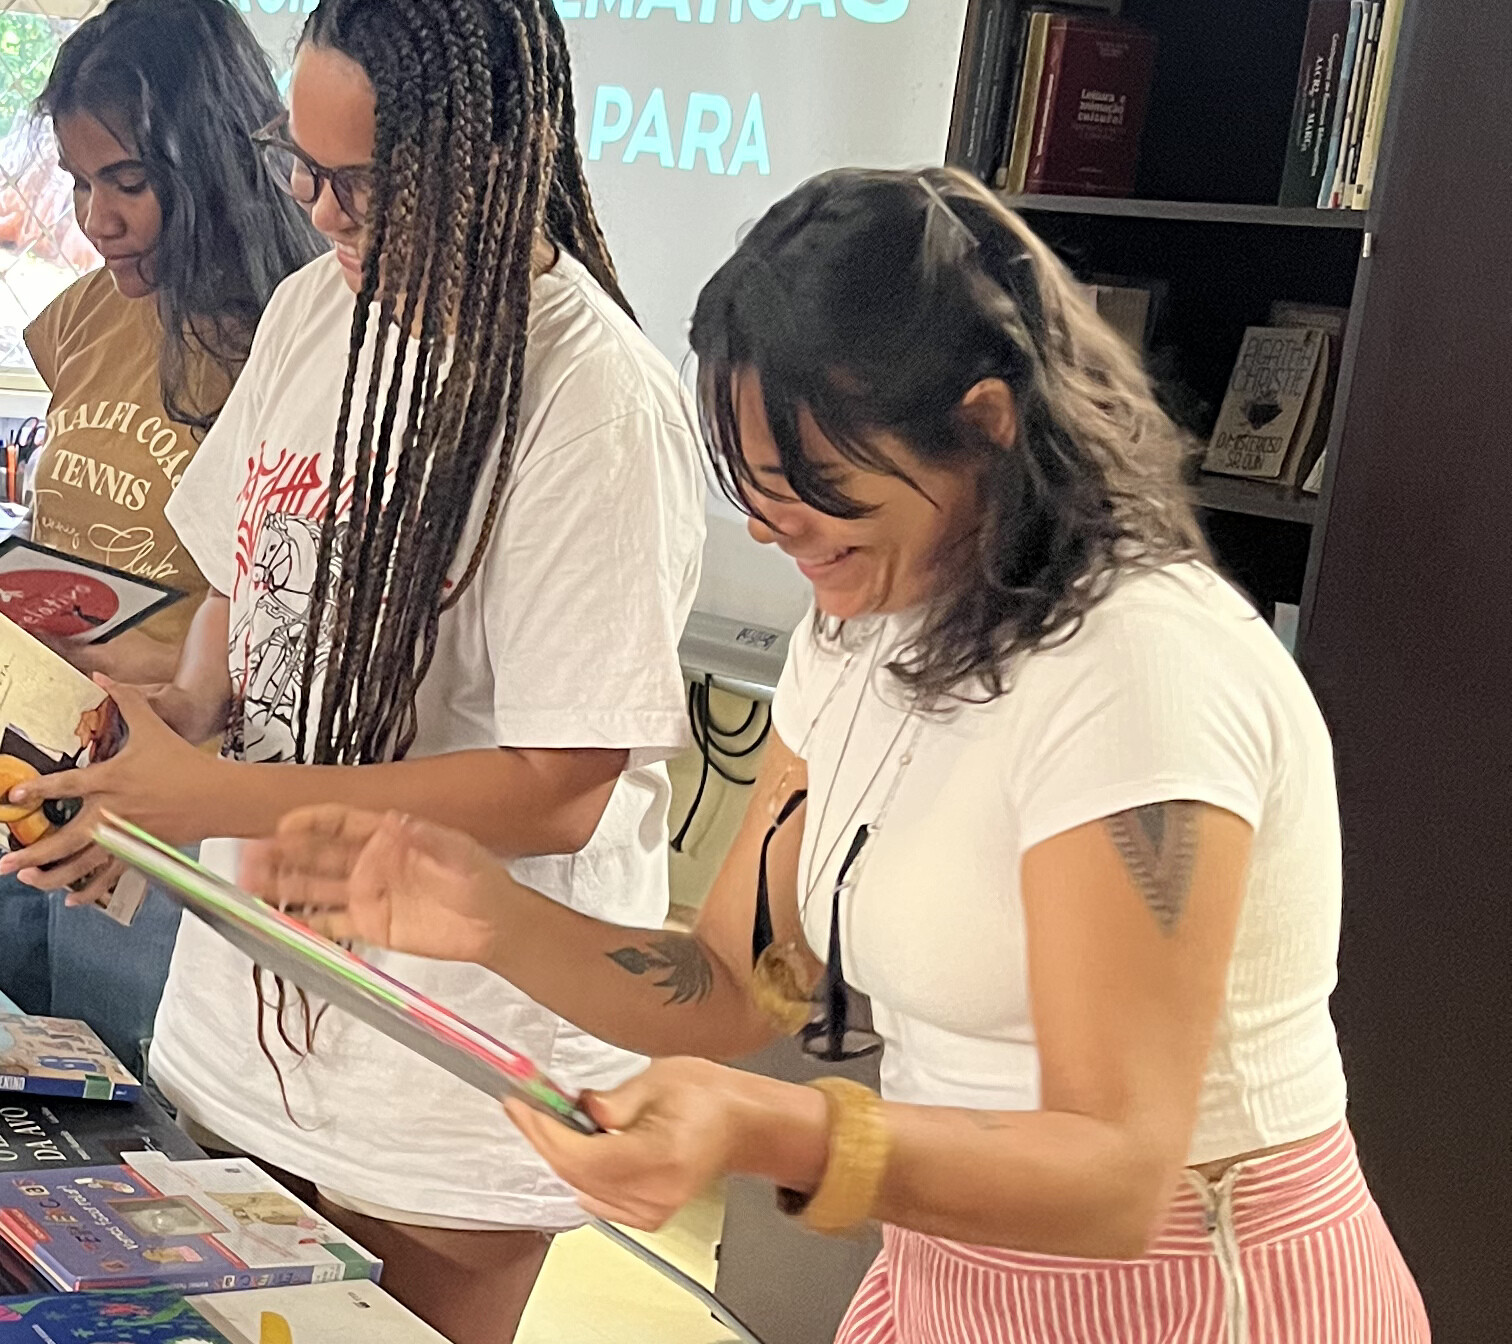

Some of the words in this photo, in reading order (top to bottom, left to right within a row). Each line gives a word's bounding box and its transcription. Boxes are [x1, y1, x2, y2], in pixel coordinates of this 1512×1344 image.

[589, 86, 770, 176] PARA
[50, 449, 151, 510] TENNIS
[25, 1140, 67, 1160] DA
